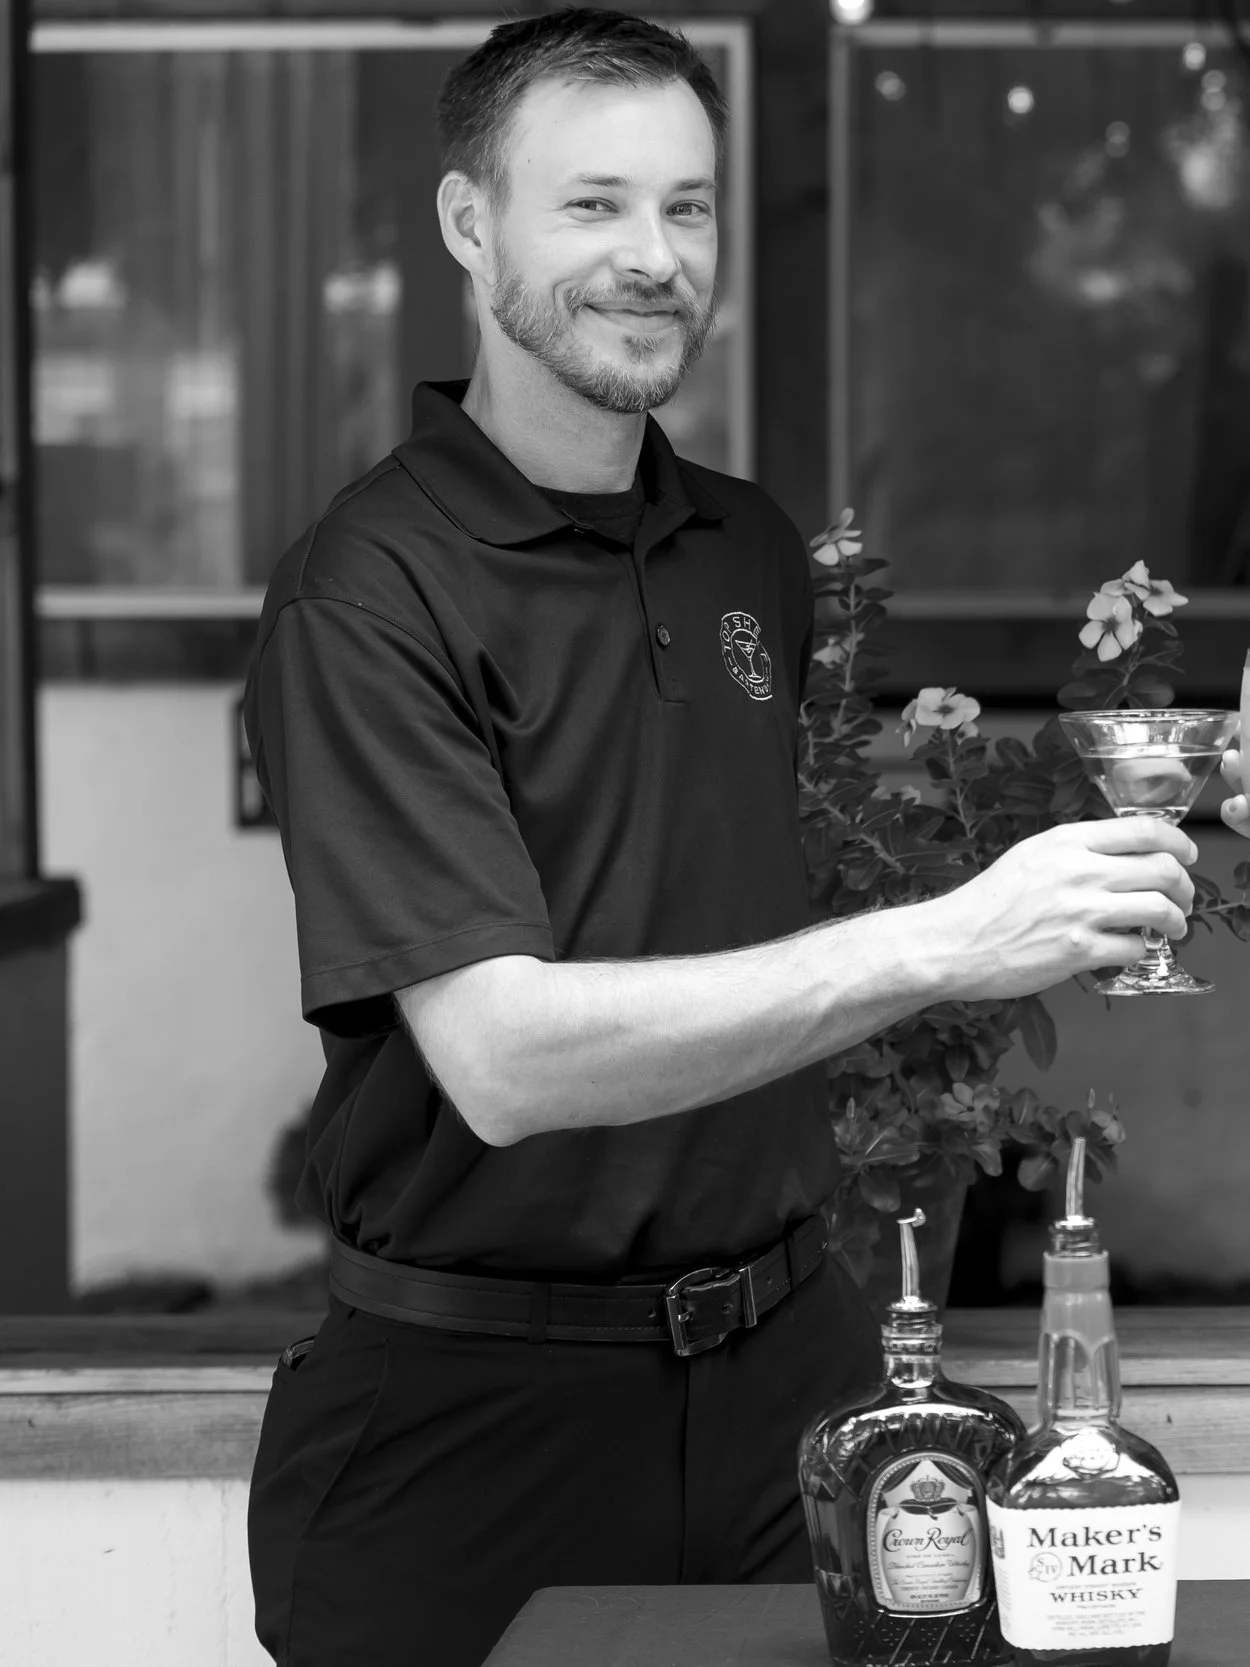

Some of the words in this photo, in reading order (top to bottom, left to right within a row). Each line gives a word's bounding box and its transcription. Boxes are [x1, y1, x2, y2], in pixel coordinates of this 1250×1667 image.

[883, 1528, 924, 1553] Crown
[914, 1527, 974, 1552] Royal
[1027, 1524, 1162, 1549] Maker's
[1067, 1551, 1161, 1578] Mark
[1049, 1588, 1144, 1603] WHISKY
